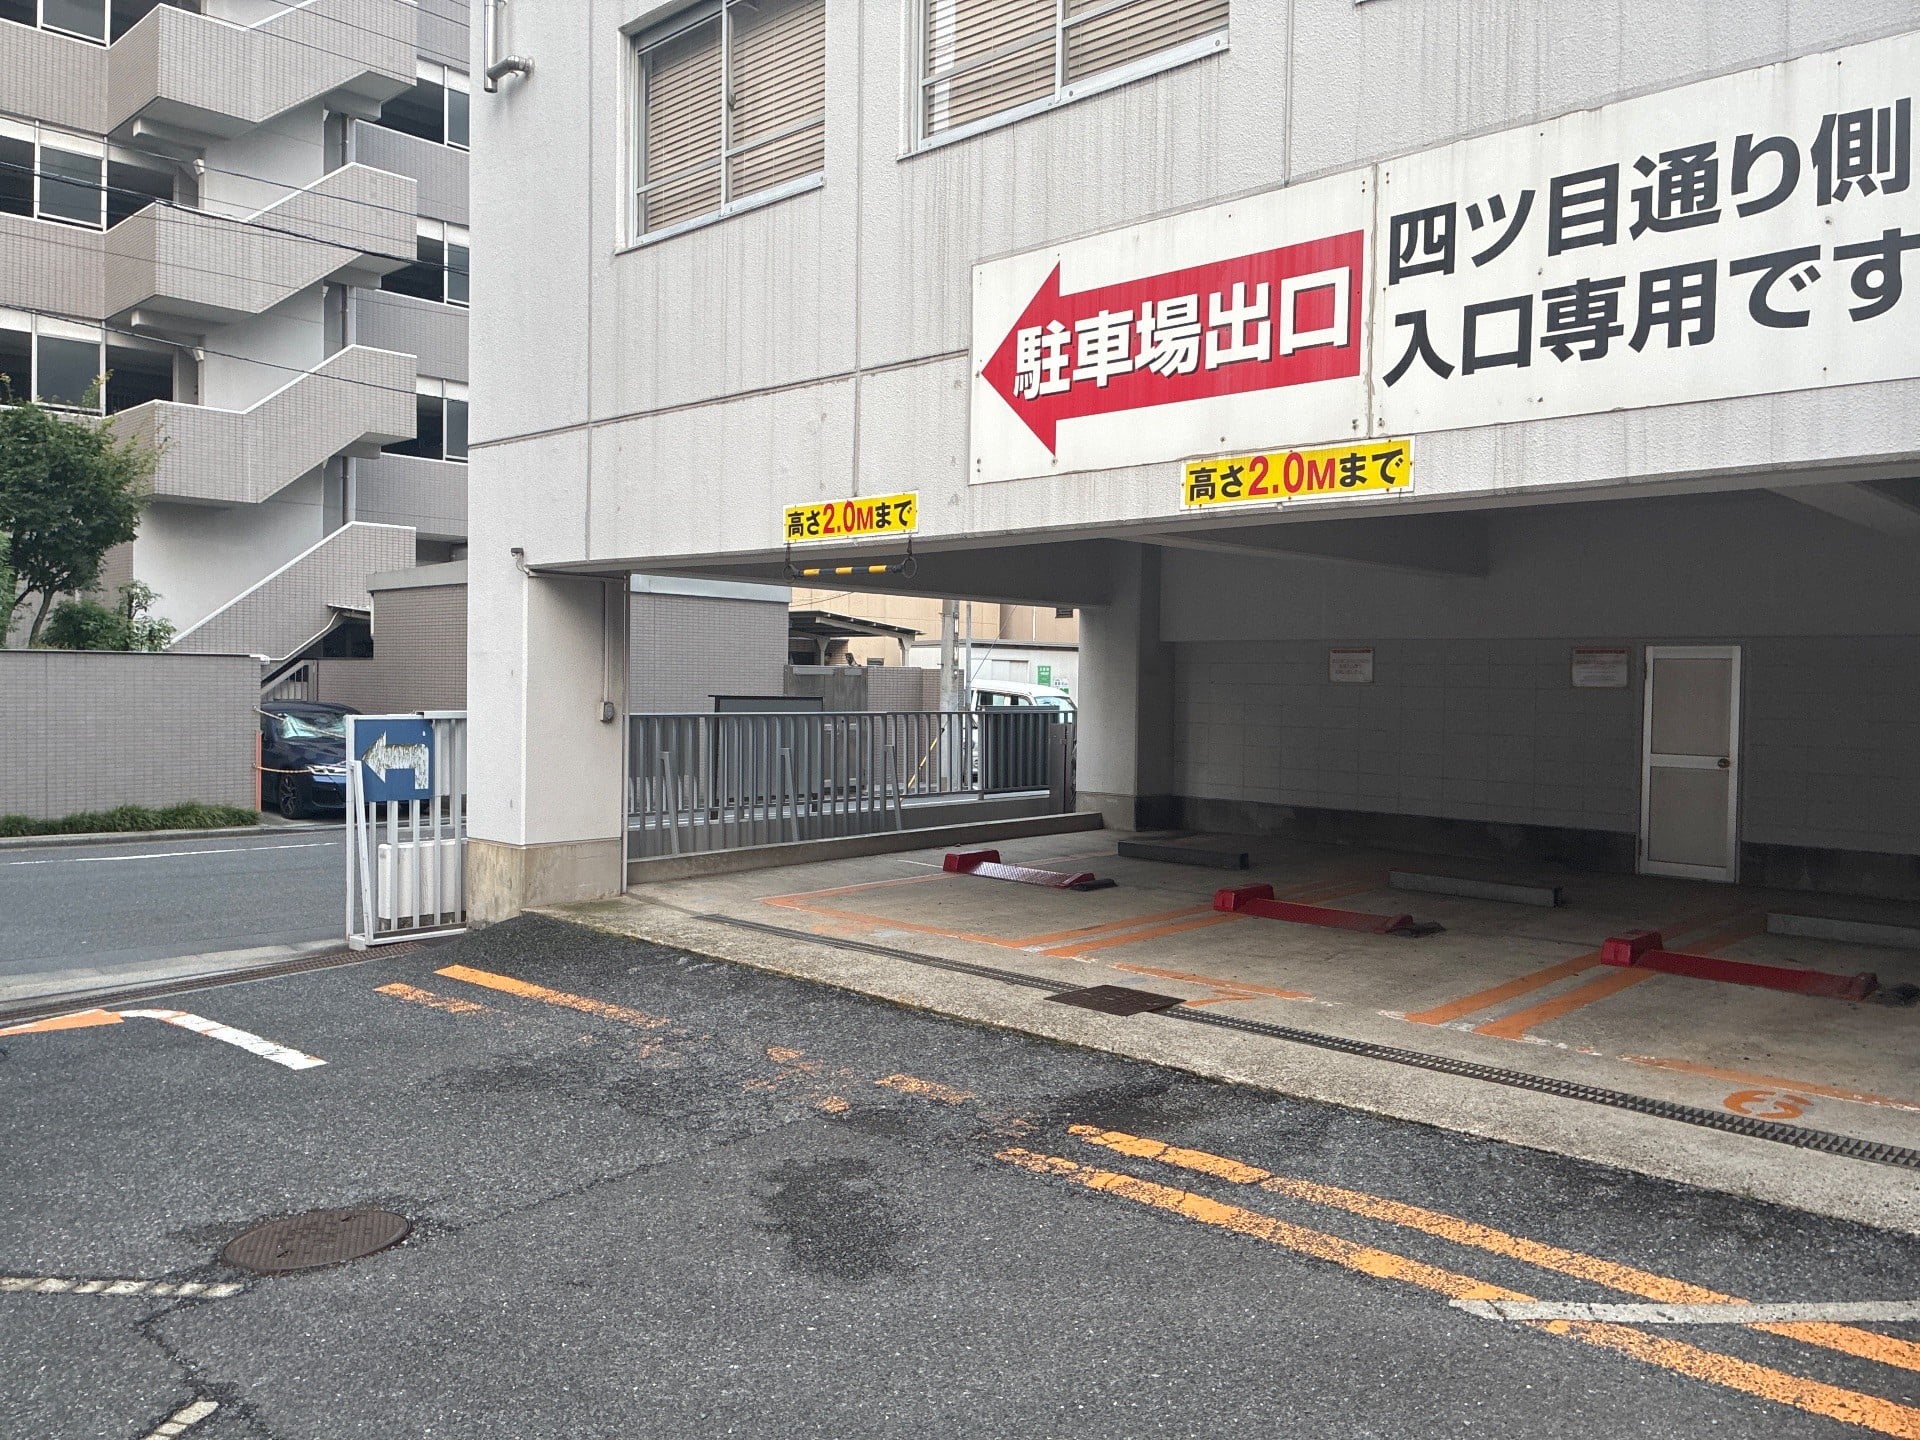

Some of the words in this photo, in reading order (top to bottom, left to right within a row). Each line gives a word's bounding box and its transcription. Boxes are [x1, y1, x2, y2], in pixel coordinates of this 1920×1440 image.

[1388, 96, 1912, 286] 四ツ目通り側
[1012, 266, 1351, 400] 駐車場出口
[1382, 227, 1920, 388] 入口専用です
[787, 500, 912, 537] 高さ2.0Mまで
[1188, 448, 1404, 501] 高さ2.0Mまで
